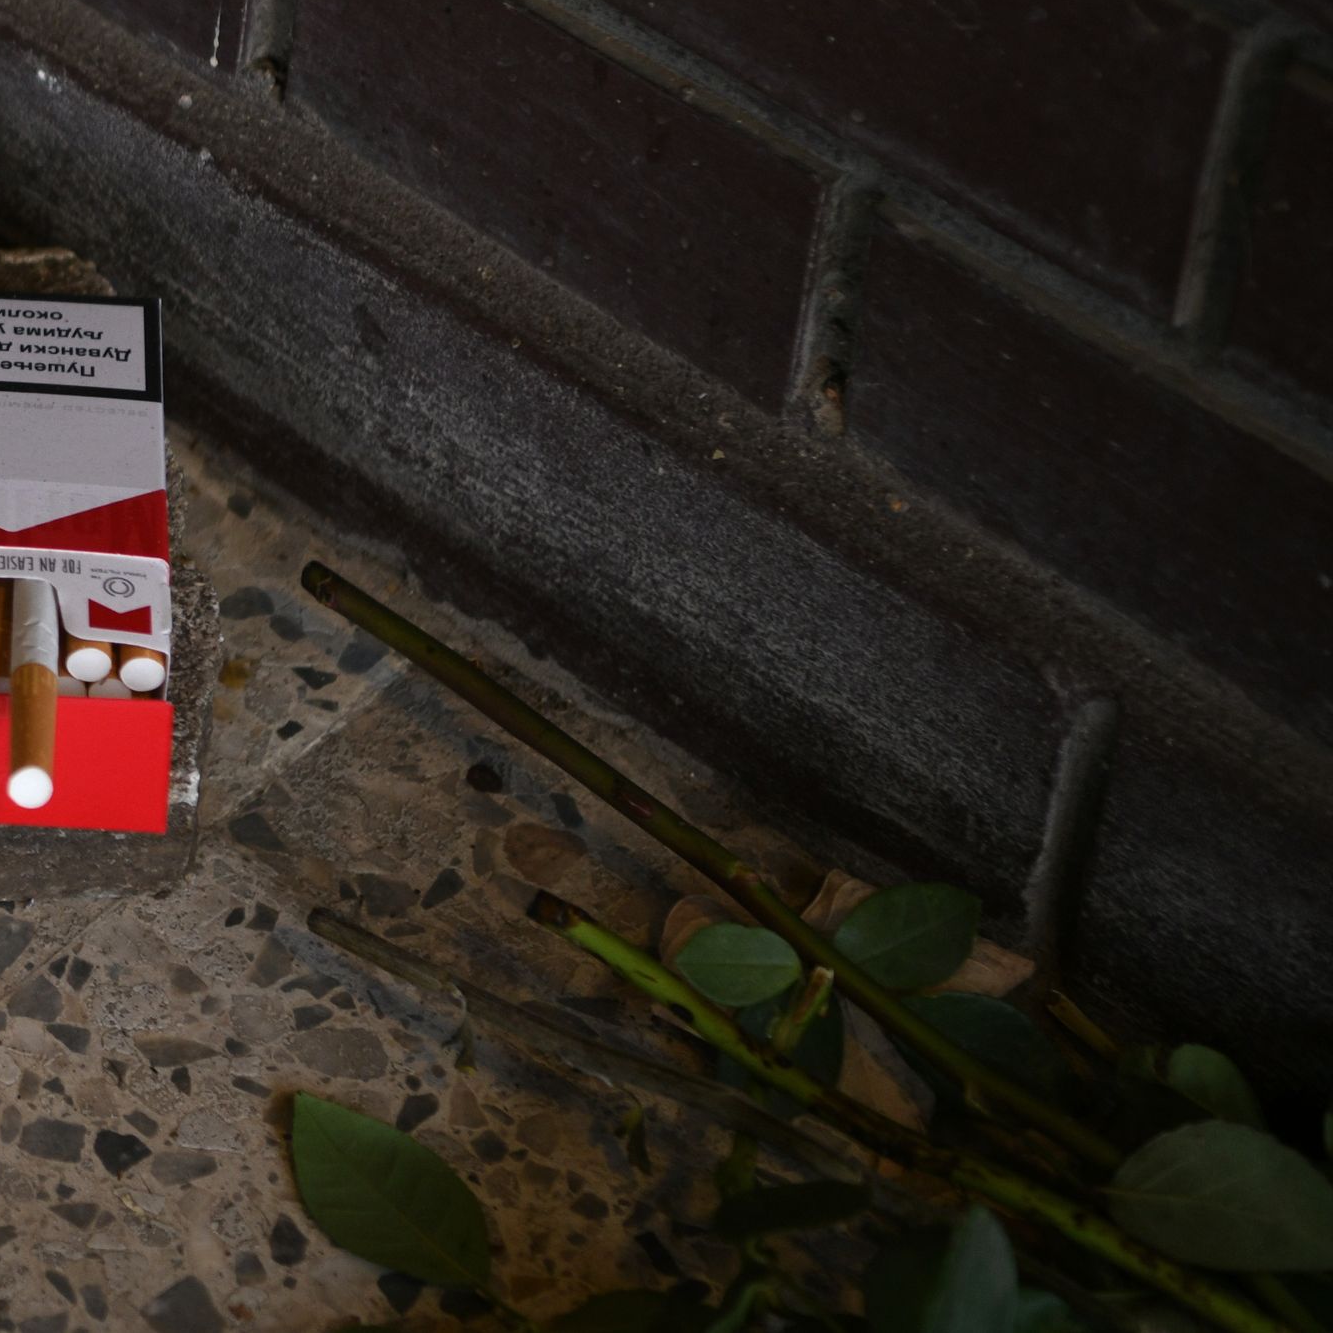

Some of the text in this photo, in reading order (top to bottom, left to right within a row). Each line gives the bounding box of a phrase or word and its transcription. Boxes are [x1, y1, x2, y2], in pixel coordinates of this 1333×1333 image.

[12, 325, 104, 342] људима
[19, 344, 132, 362] Дувански
[0, 360, 96, 378] Пушење
[39, 557, 57, 573] AN
[61, 558, 83, 575] FOR
